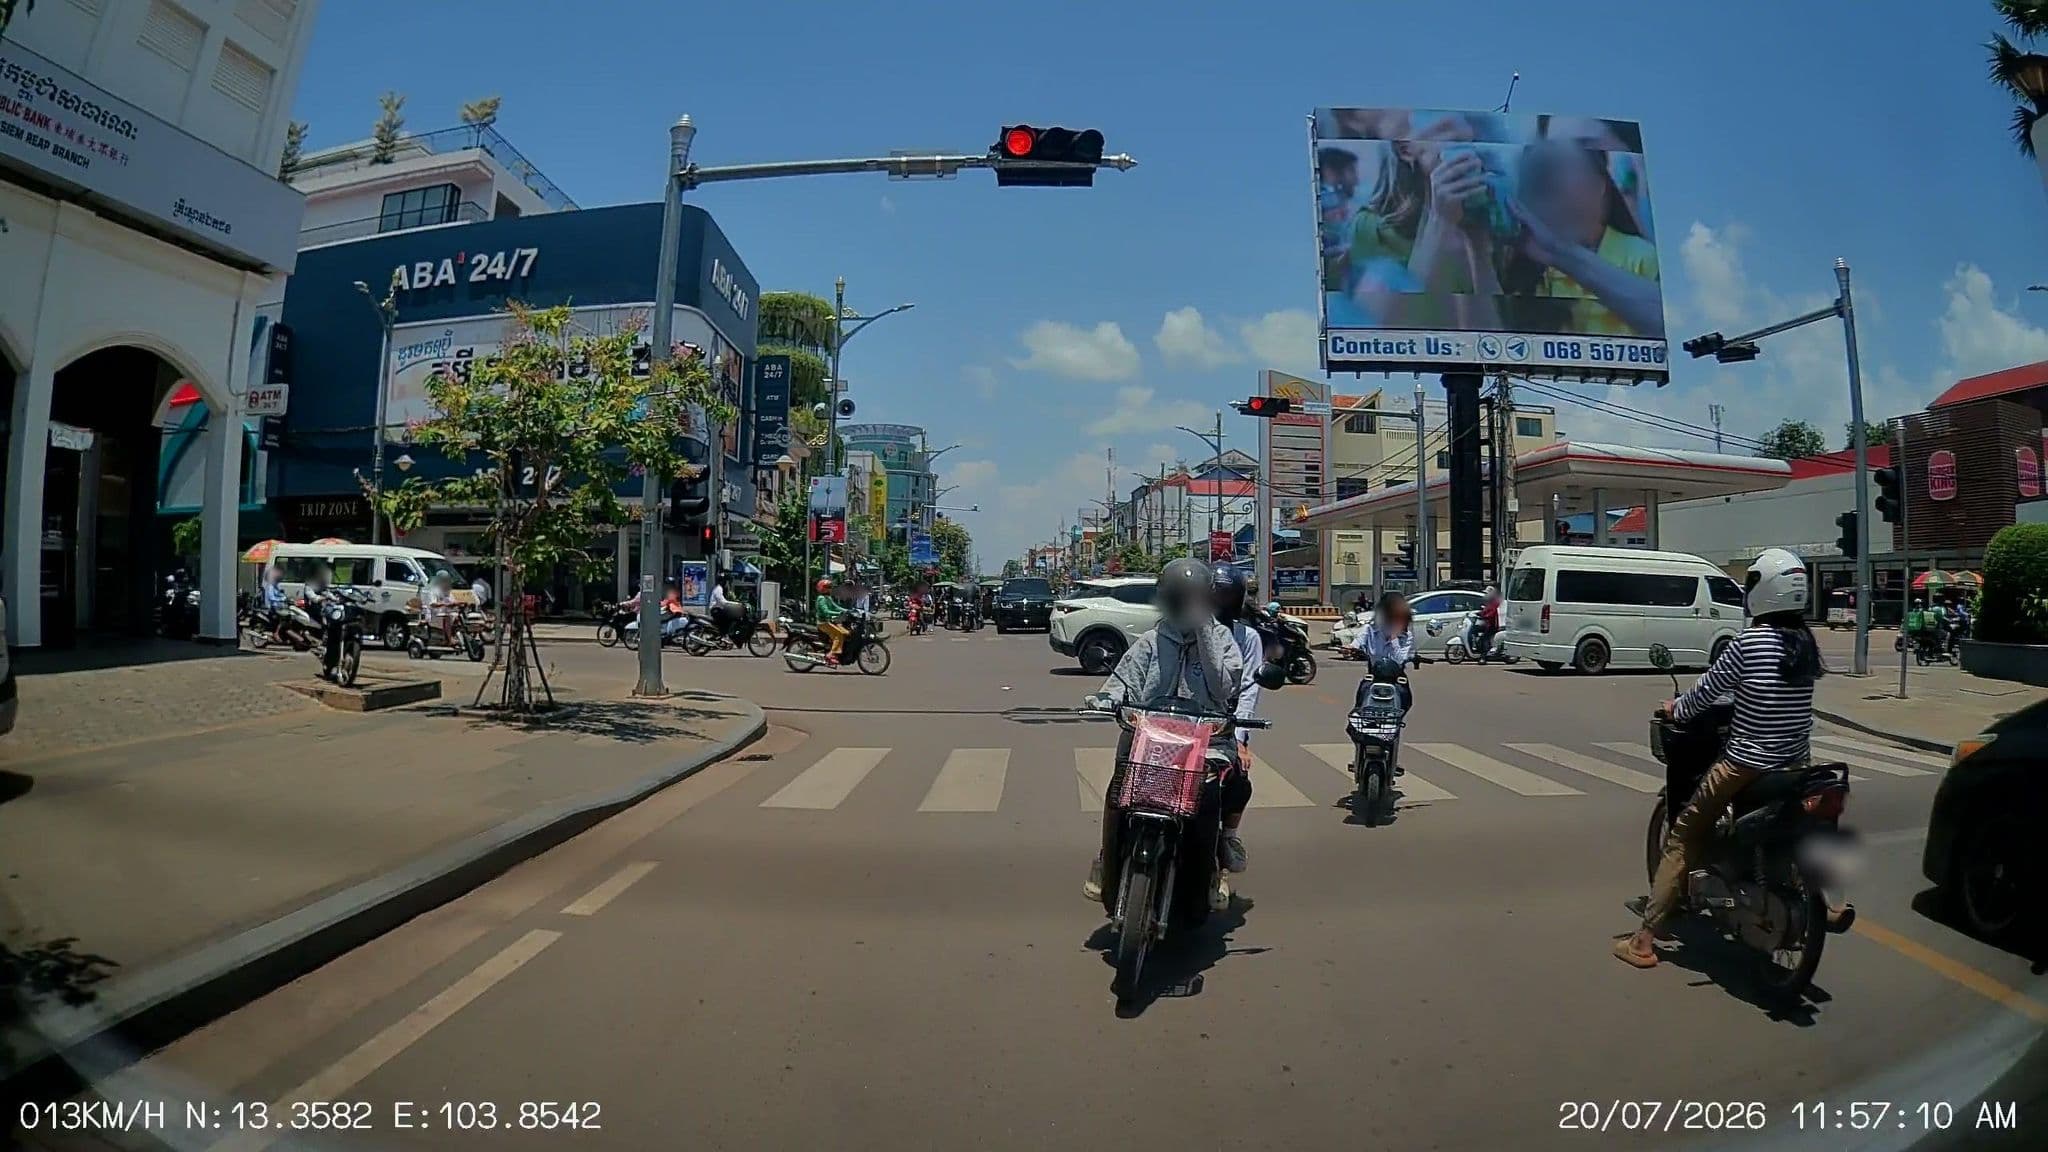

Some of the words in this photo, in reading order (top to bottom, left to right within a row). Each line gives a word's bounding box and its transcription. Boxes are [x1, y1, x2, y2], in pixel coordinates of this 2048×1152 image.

[22, 107, 52, 131] BANK
[0, 120, 24, 140] SIEM
[25, 132, 50, 150] REAP
[52, 143, 90, 169] BRANCH
[469, 248, 538, 282] 24/7
[1331, 336, 1416, 355] Contact
[1425, 337, 1462, 356] Us:
[1543, 341, 1582, 360] 068
[764, 371, 783, 379] 24/7
[261, 390, 282, 401] ATM
[300, 503, 326, 516] TRIP
[329, 501, 358, 516] ZONE
